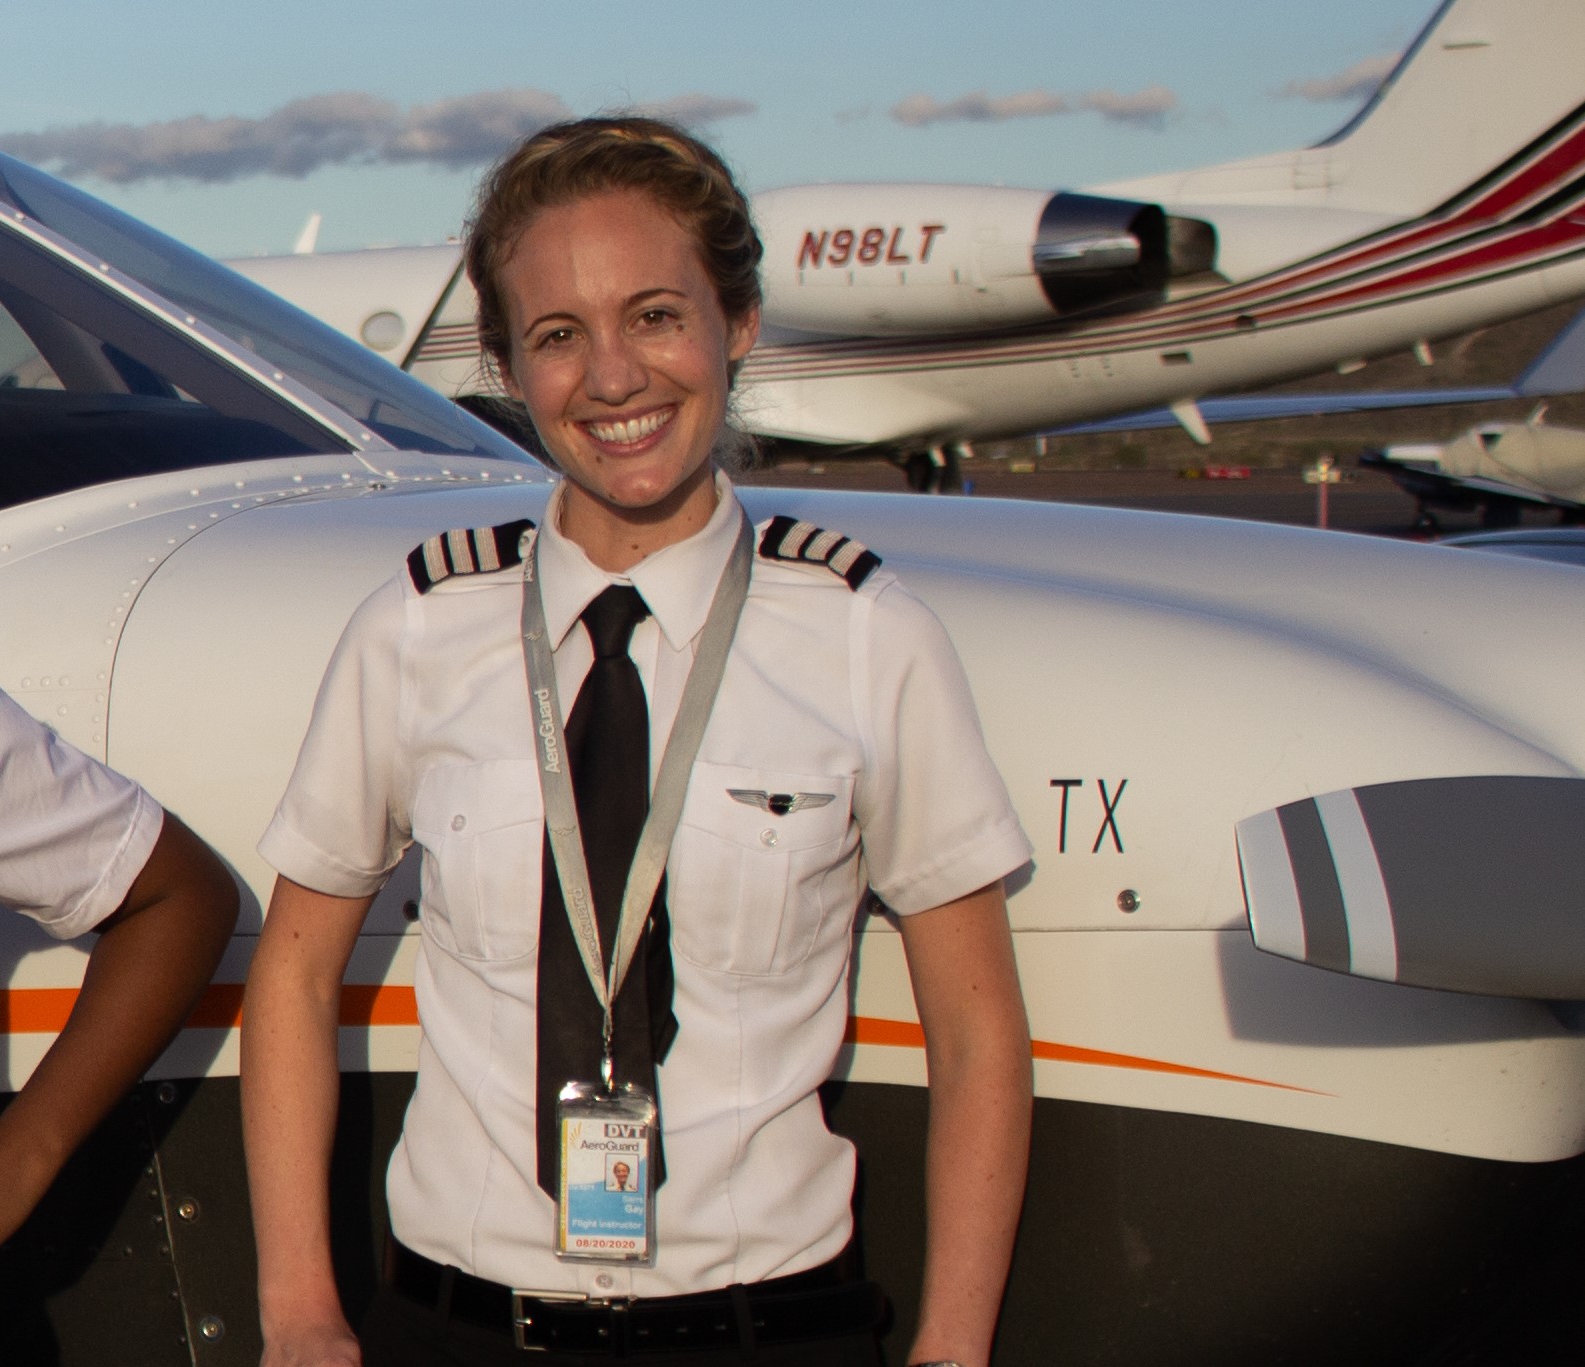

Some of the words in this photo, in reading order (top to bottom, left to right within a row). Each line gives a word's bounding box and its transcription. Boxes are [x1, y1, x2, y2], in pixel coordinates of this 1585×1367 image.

[797, 224, 946, 269] N98LT
[534, 688, 561, 774] AeroGuard
[1050, 779, 1128, 854] TX
[607, 1124, 644, 1138] DVT
[580, 1140, 639, 1152] AeroGuard
[572, 1219, 598, 1230] Flight
[575, 1239, 635, 1249] 08/20/2020
